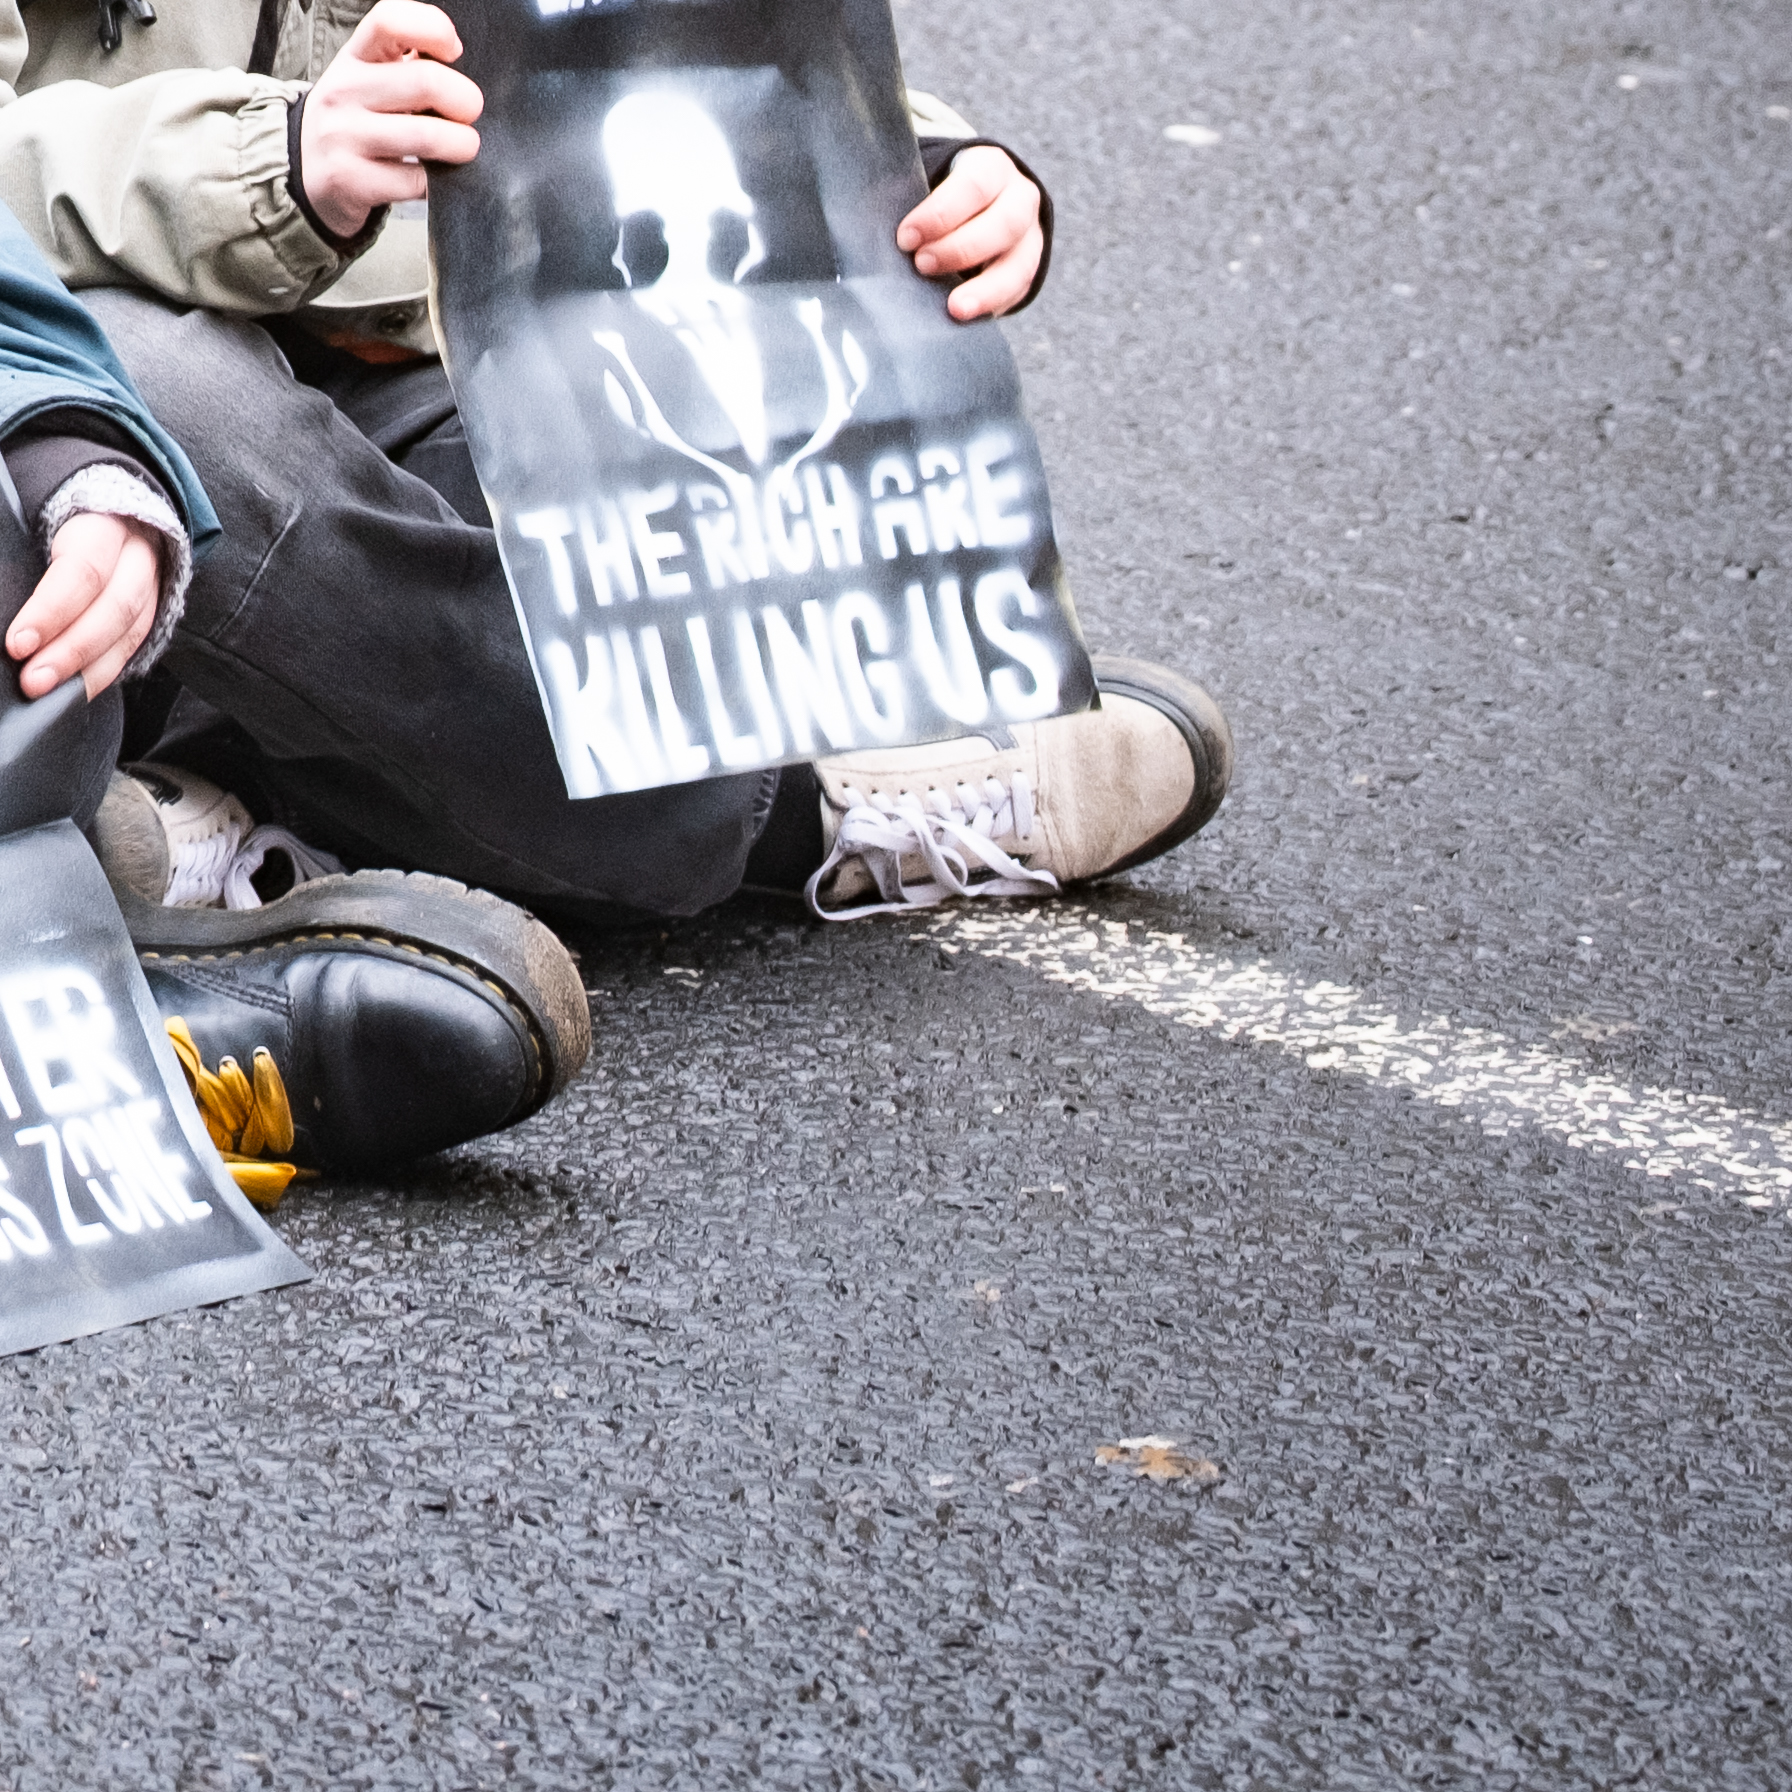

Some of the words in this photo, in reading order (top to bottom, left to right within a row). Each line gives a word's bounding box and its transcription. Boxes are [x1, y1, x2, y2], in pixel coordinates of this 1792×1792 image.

[517, 480, 691, 617] THE
[687, 461, 862, 590] RICH
[869, 428, 1032, 560] ARE
[542, 589, 906, 798] KILLING
[906, 566, 1060, 725] US
[15, 1099, 213, 1249] ZONE
